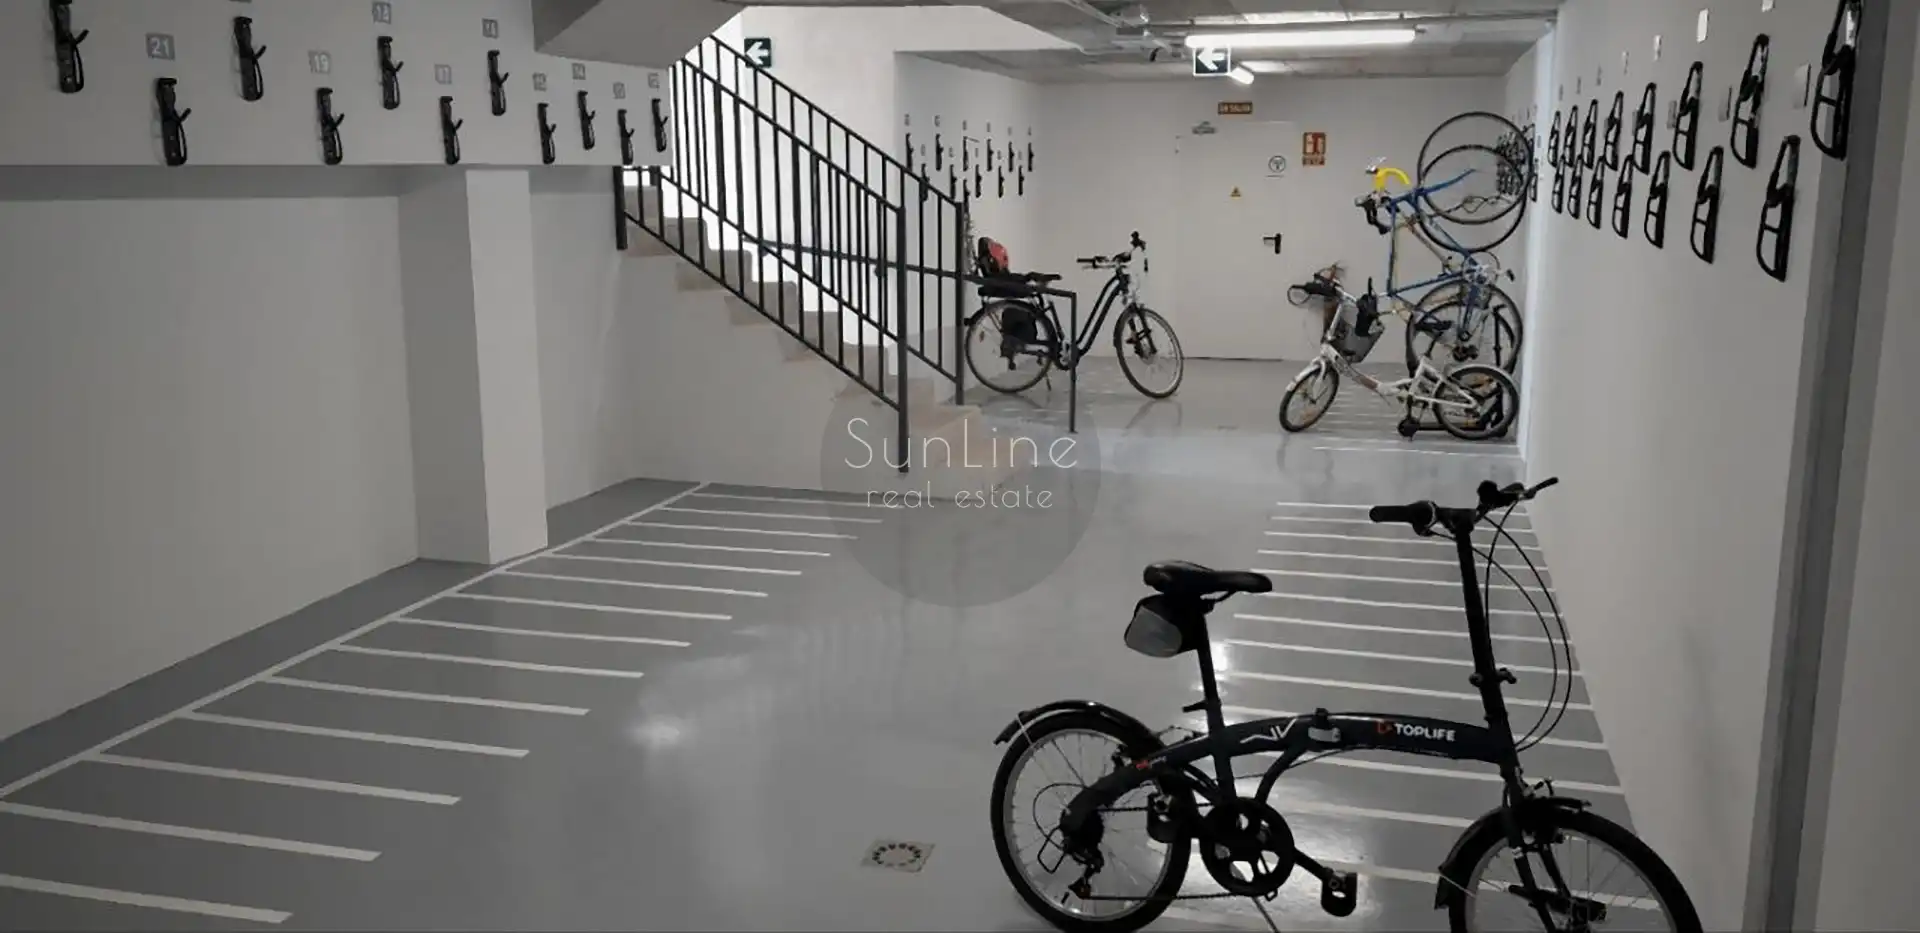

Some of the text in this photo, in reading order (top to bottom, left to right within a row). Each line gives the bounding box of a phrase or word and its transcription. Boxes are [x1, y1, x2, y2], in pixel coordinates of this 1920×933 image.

[151, 36, 170, 56] 21
[314, 54, 330, 73] 19
[1394, 722, 1457, 743] TOPLIFE
